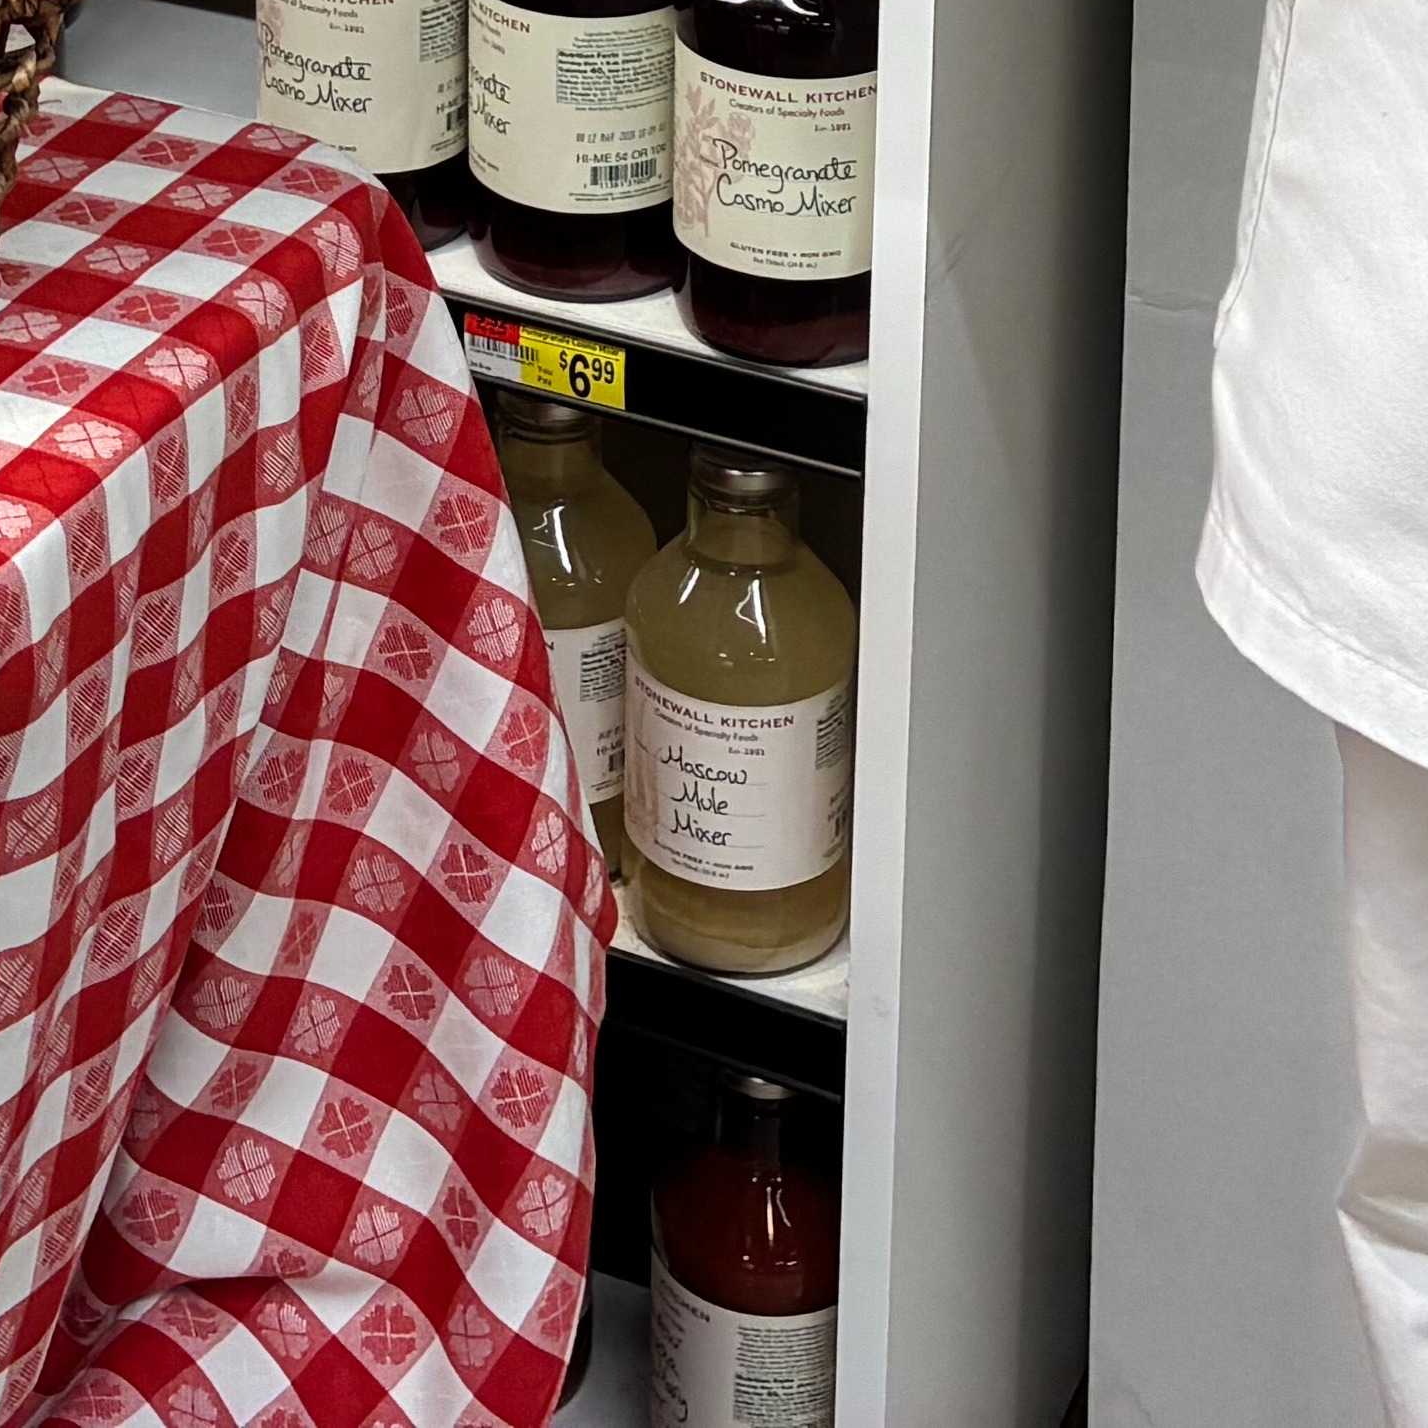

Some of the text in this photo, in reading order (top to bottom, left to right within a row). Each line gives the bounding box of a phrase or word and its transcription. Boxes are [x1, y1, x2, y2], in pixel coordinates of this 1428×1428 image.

[259, 21, 372, 83] Pomegranate
[307, 80, 372, 113] Mixer
[700, 71, 877, 104] STONEWALL KITCHEN
[712, 138, 857, 194] Pomegranate
[785, 185, 857, 217] Mixer
[634, 676, 795, 729] STONEWALL KITCHEN
[660, 744, 748, 786] Moscow
[668, 783, 730, 816] Mule
[671, 809, 733, 847] Mixer
